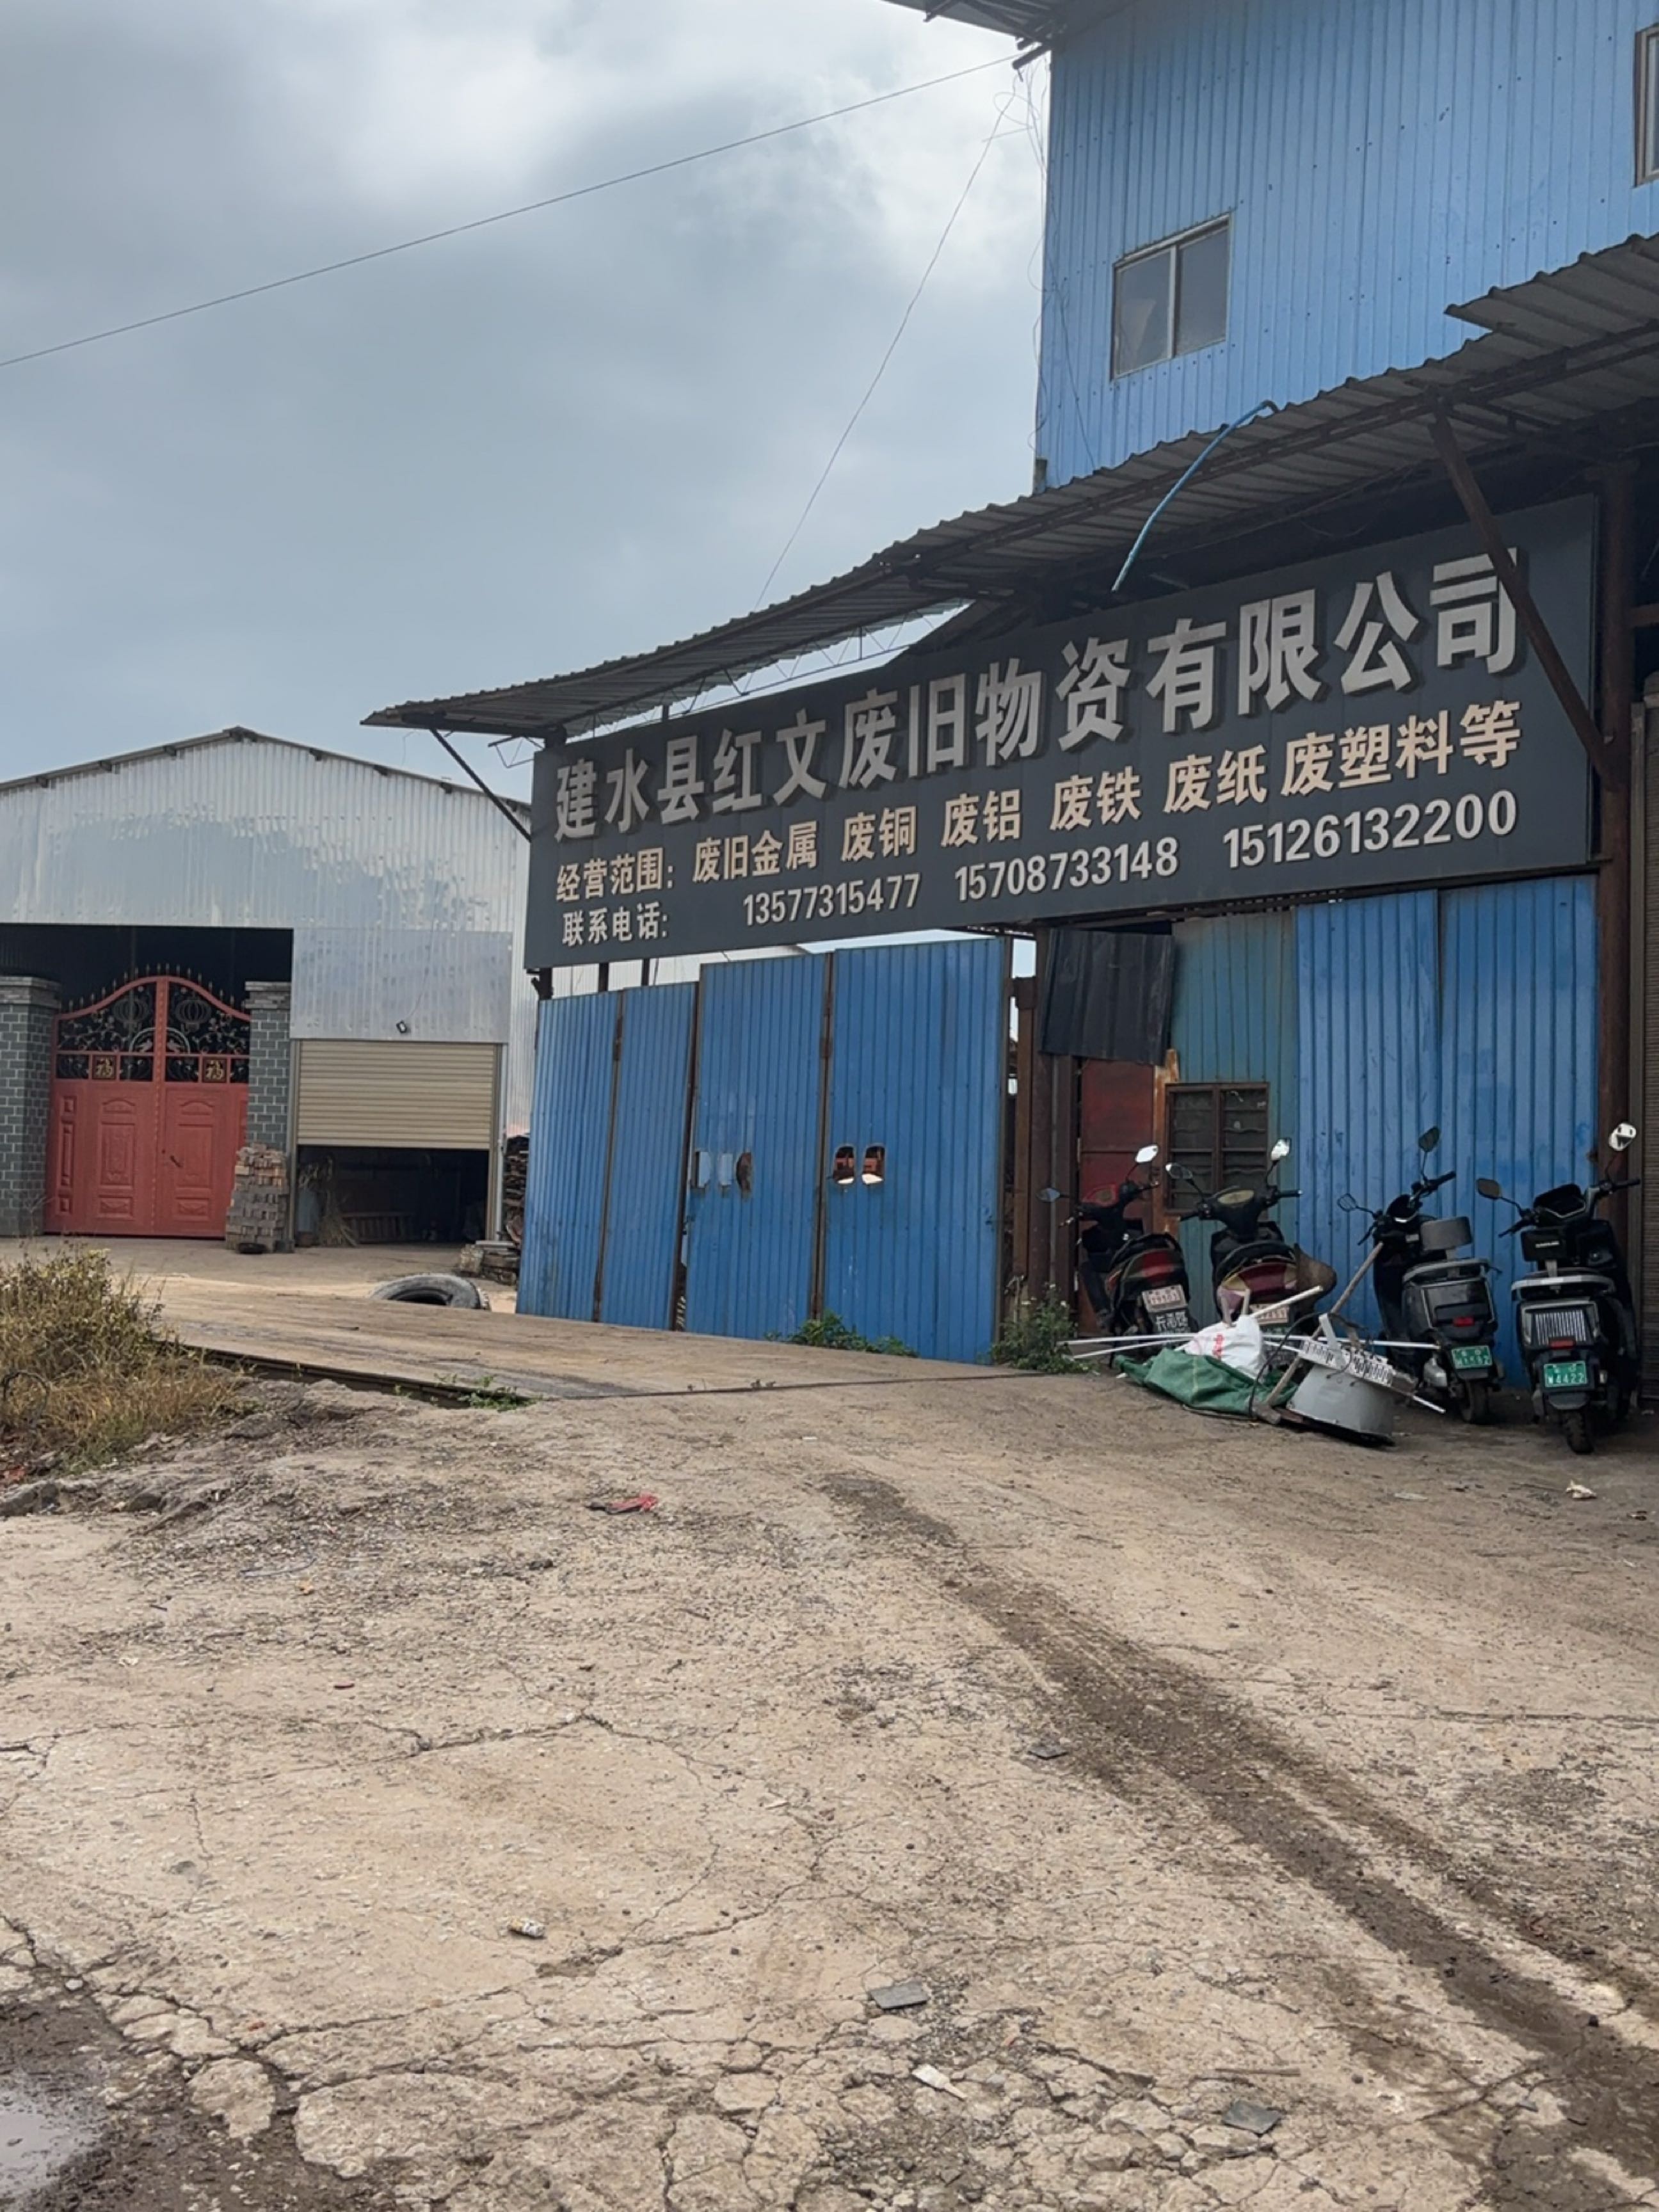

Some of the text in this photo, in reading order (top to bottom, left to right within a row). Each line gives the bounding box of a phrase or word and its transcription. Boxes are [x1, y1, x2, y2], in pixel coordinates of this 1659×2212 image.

[556, 547, 1518, 840] 建水县红文废旧物资有限公司
[693, 821, 819, 883] 废旧金属
[841, 806, 917, 862] 废铜
[941, 789, 1021, 847] 废铝
[1050, 766, 1141, 831] 废铁
[1163, 744, 1267, 814] 废纸
[1281, 700, 1521, 796] 废塑料等
[742, 874, 921, 927] 13577315477
[954, 838, 1179, 902] 15708733148
[1223, 790, 1517, 869] 15126132200
